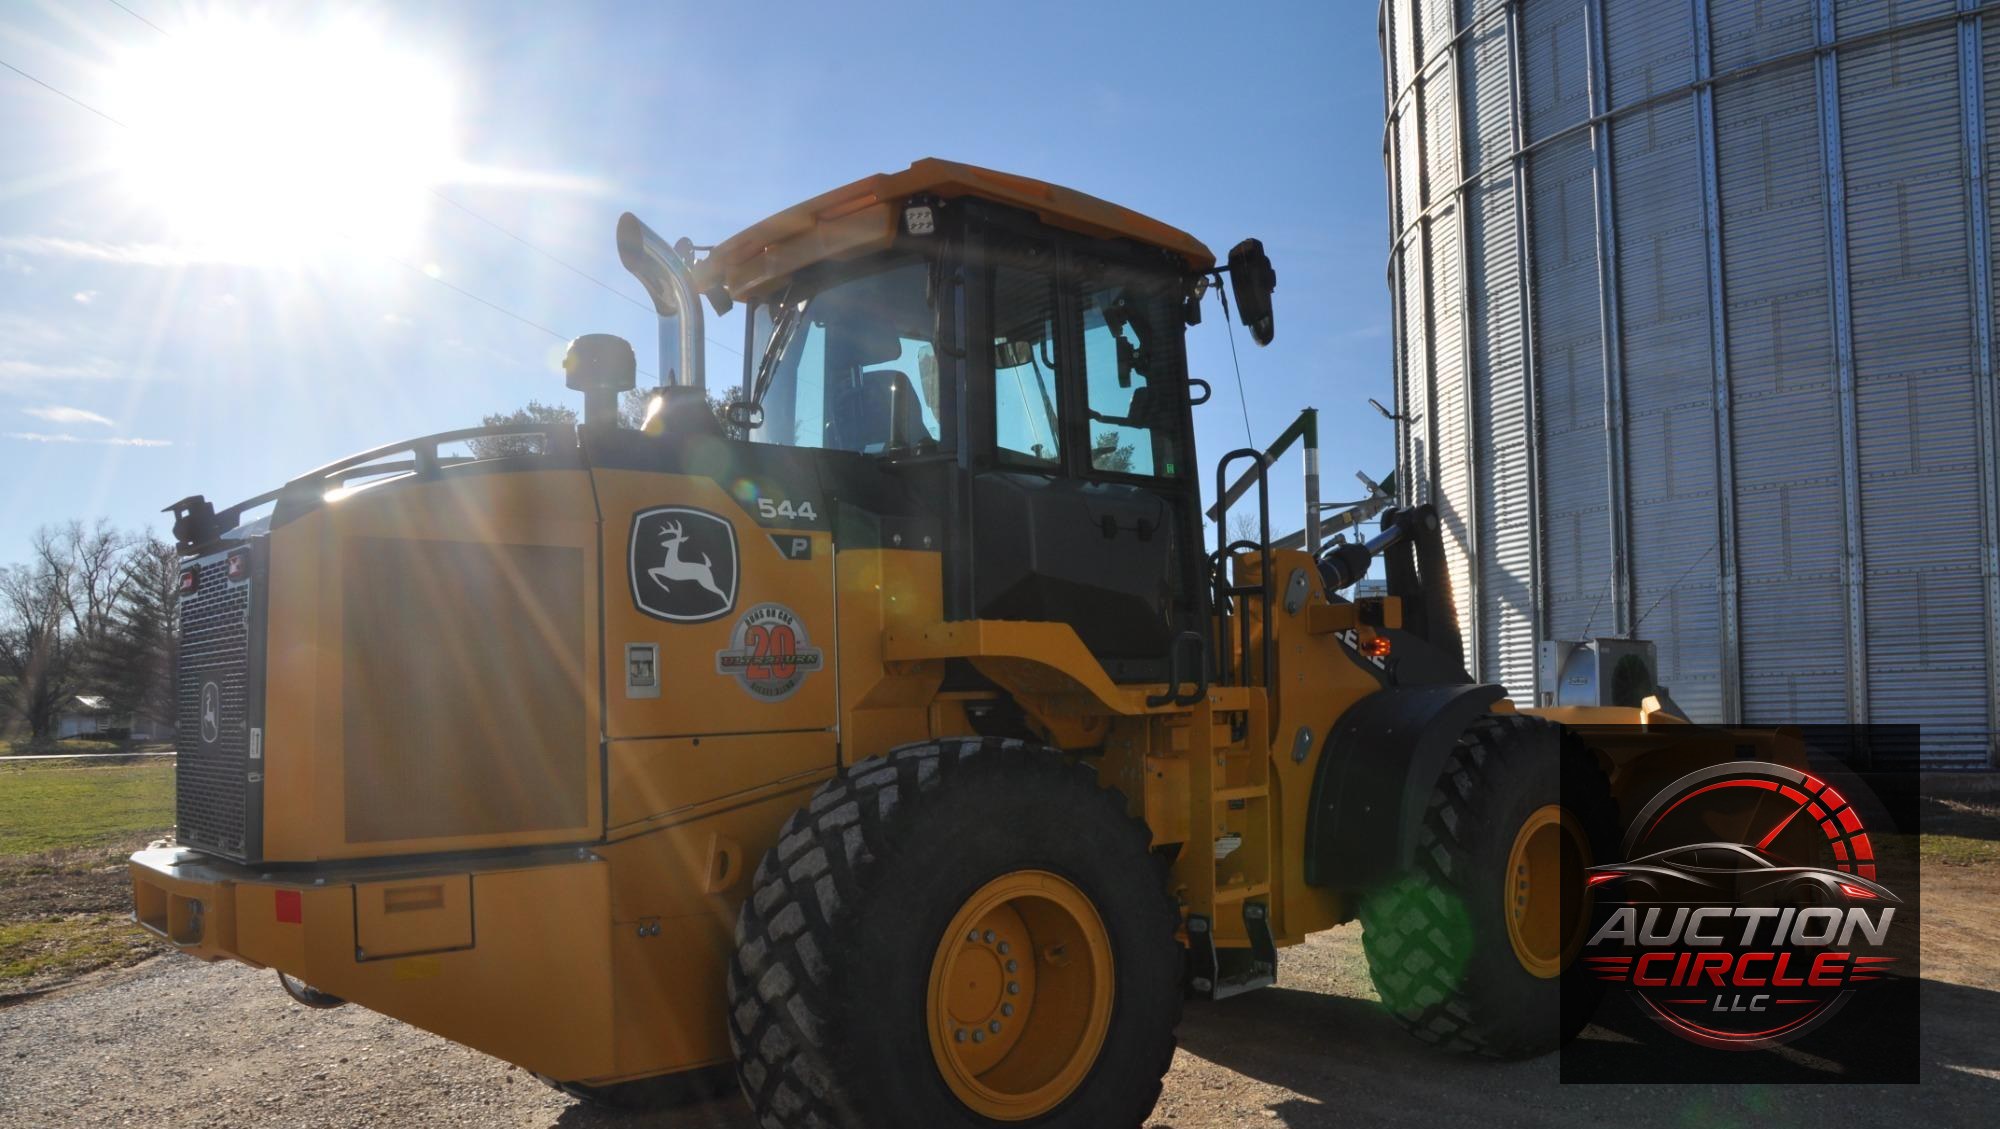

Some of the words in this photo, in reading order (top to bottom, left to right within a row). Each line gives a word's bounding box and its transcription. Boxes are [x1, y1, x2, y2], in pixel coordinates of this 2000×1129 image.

[758, 498, 817, 521] 544
[791, 538, 808, 557] P
[744, 624, 797, 681] 20
